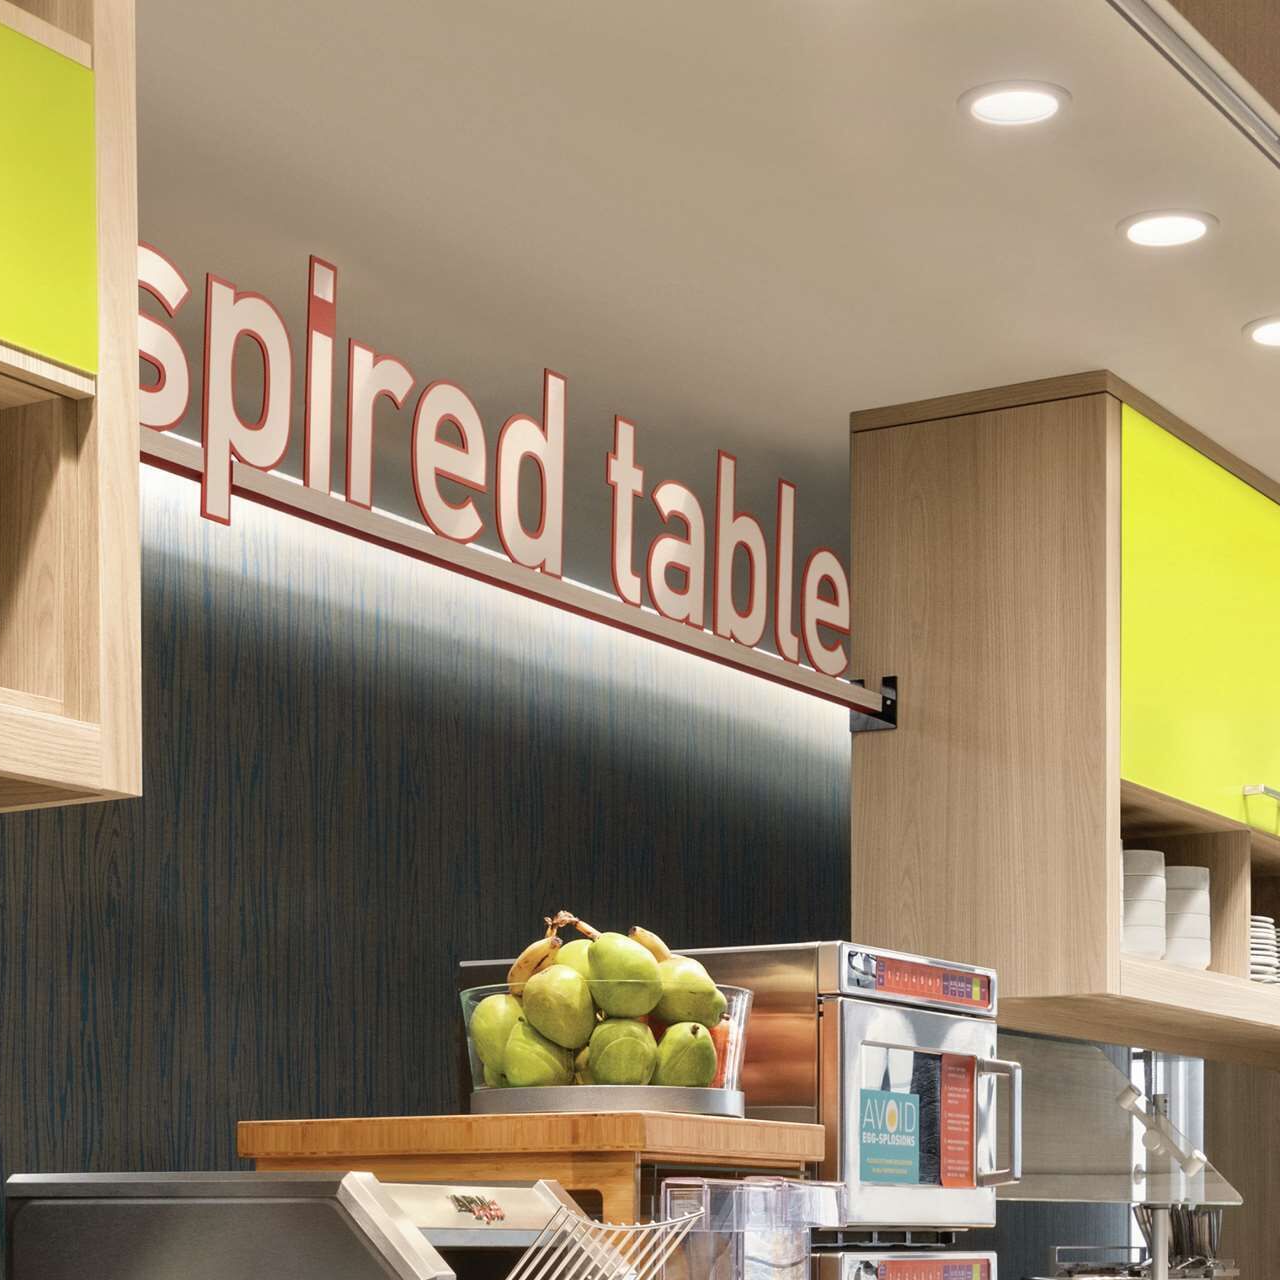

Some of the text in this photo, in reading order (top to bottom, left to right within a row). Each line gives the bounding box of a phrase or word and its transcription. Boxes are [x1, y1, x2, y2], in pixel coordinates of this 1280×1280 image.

[606, 414, 851, 677] table
[862, 1098, 917, 1134] AVOID
[862, 1131, 916, 1147] EGG-SPLOSIONS
